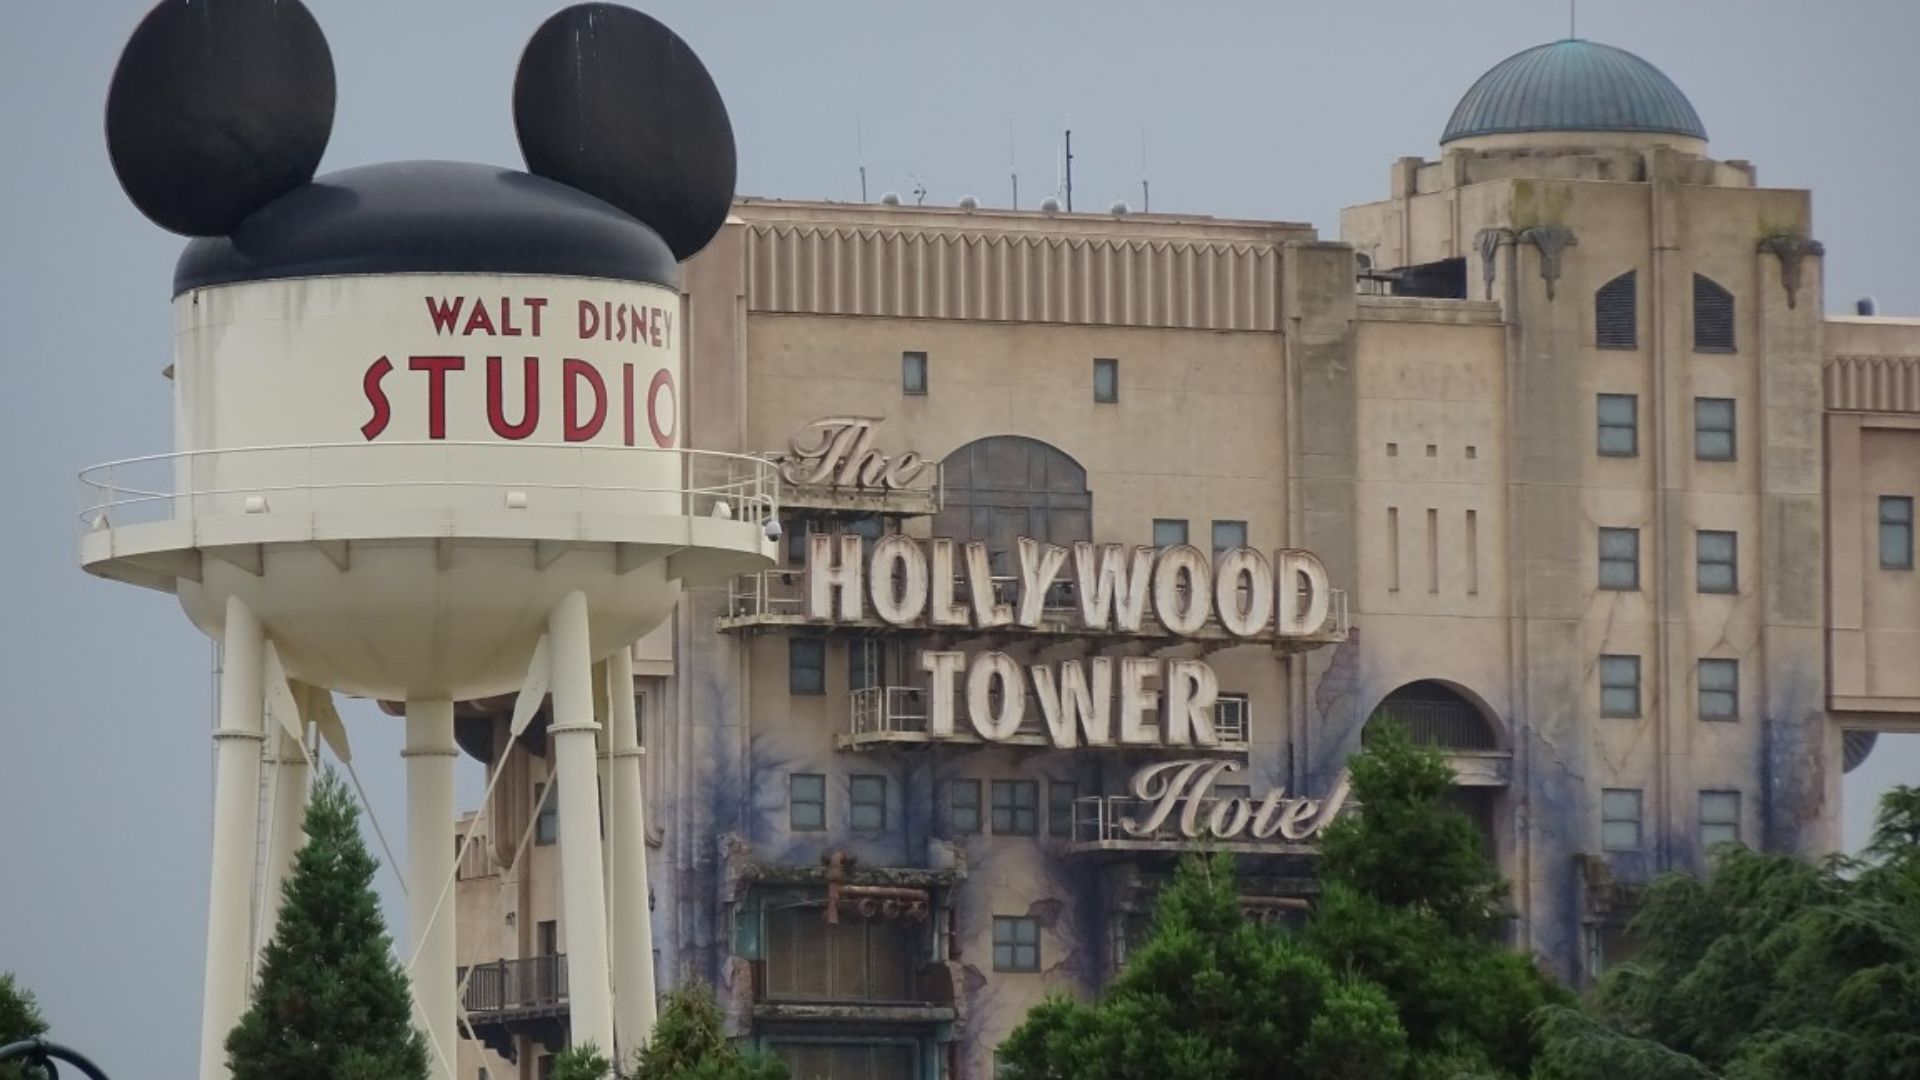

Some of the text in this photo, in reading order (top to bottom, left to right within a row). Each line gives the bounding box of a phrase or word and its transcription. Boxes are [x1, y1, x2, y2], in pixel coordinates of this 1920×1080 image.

[425, 296, 673, 349] WALT DISNEY
[360, 354, 677, 449] STUDIO
[779, 416, 926, 490] The
[807, 533, 1330, 638] HOLLYWOOD
[920, 650, 1221, 749] TOWER
[1121, 759, 1352, 840] Hotel
